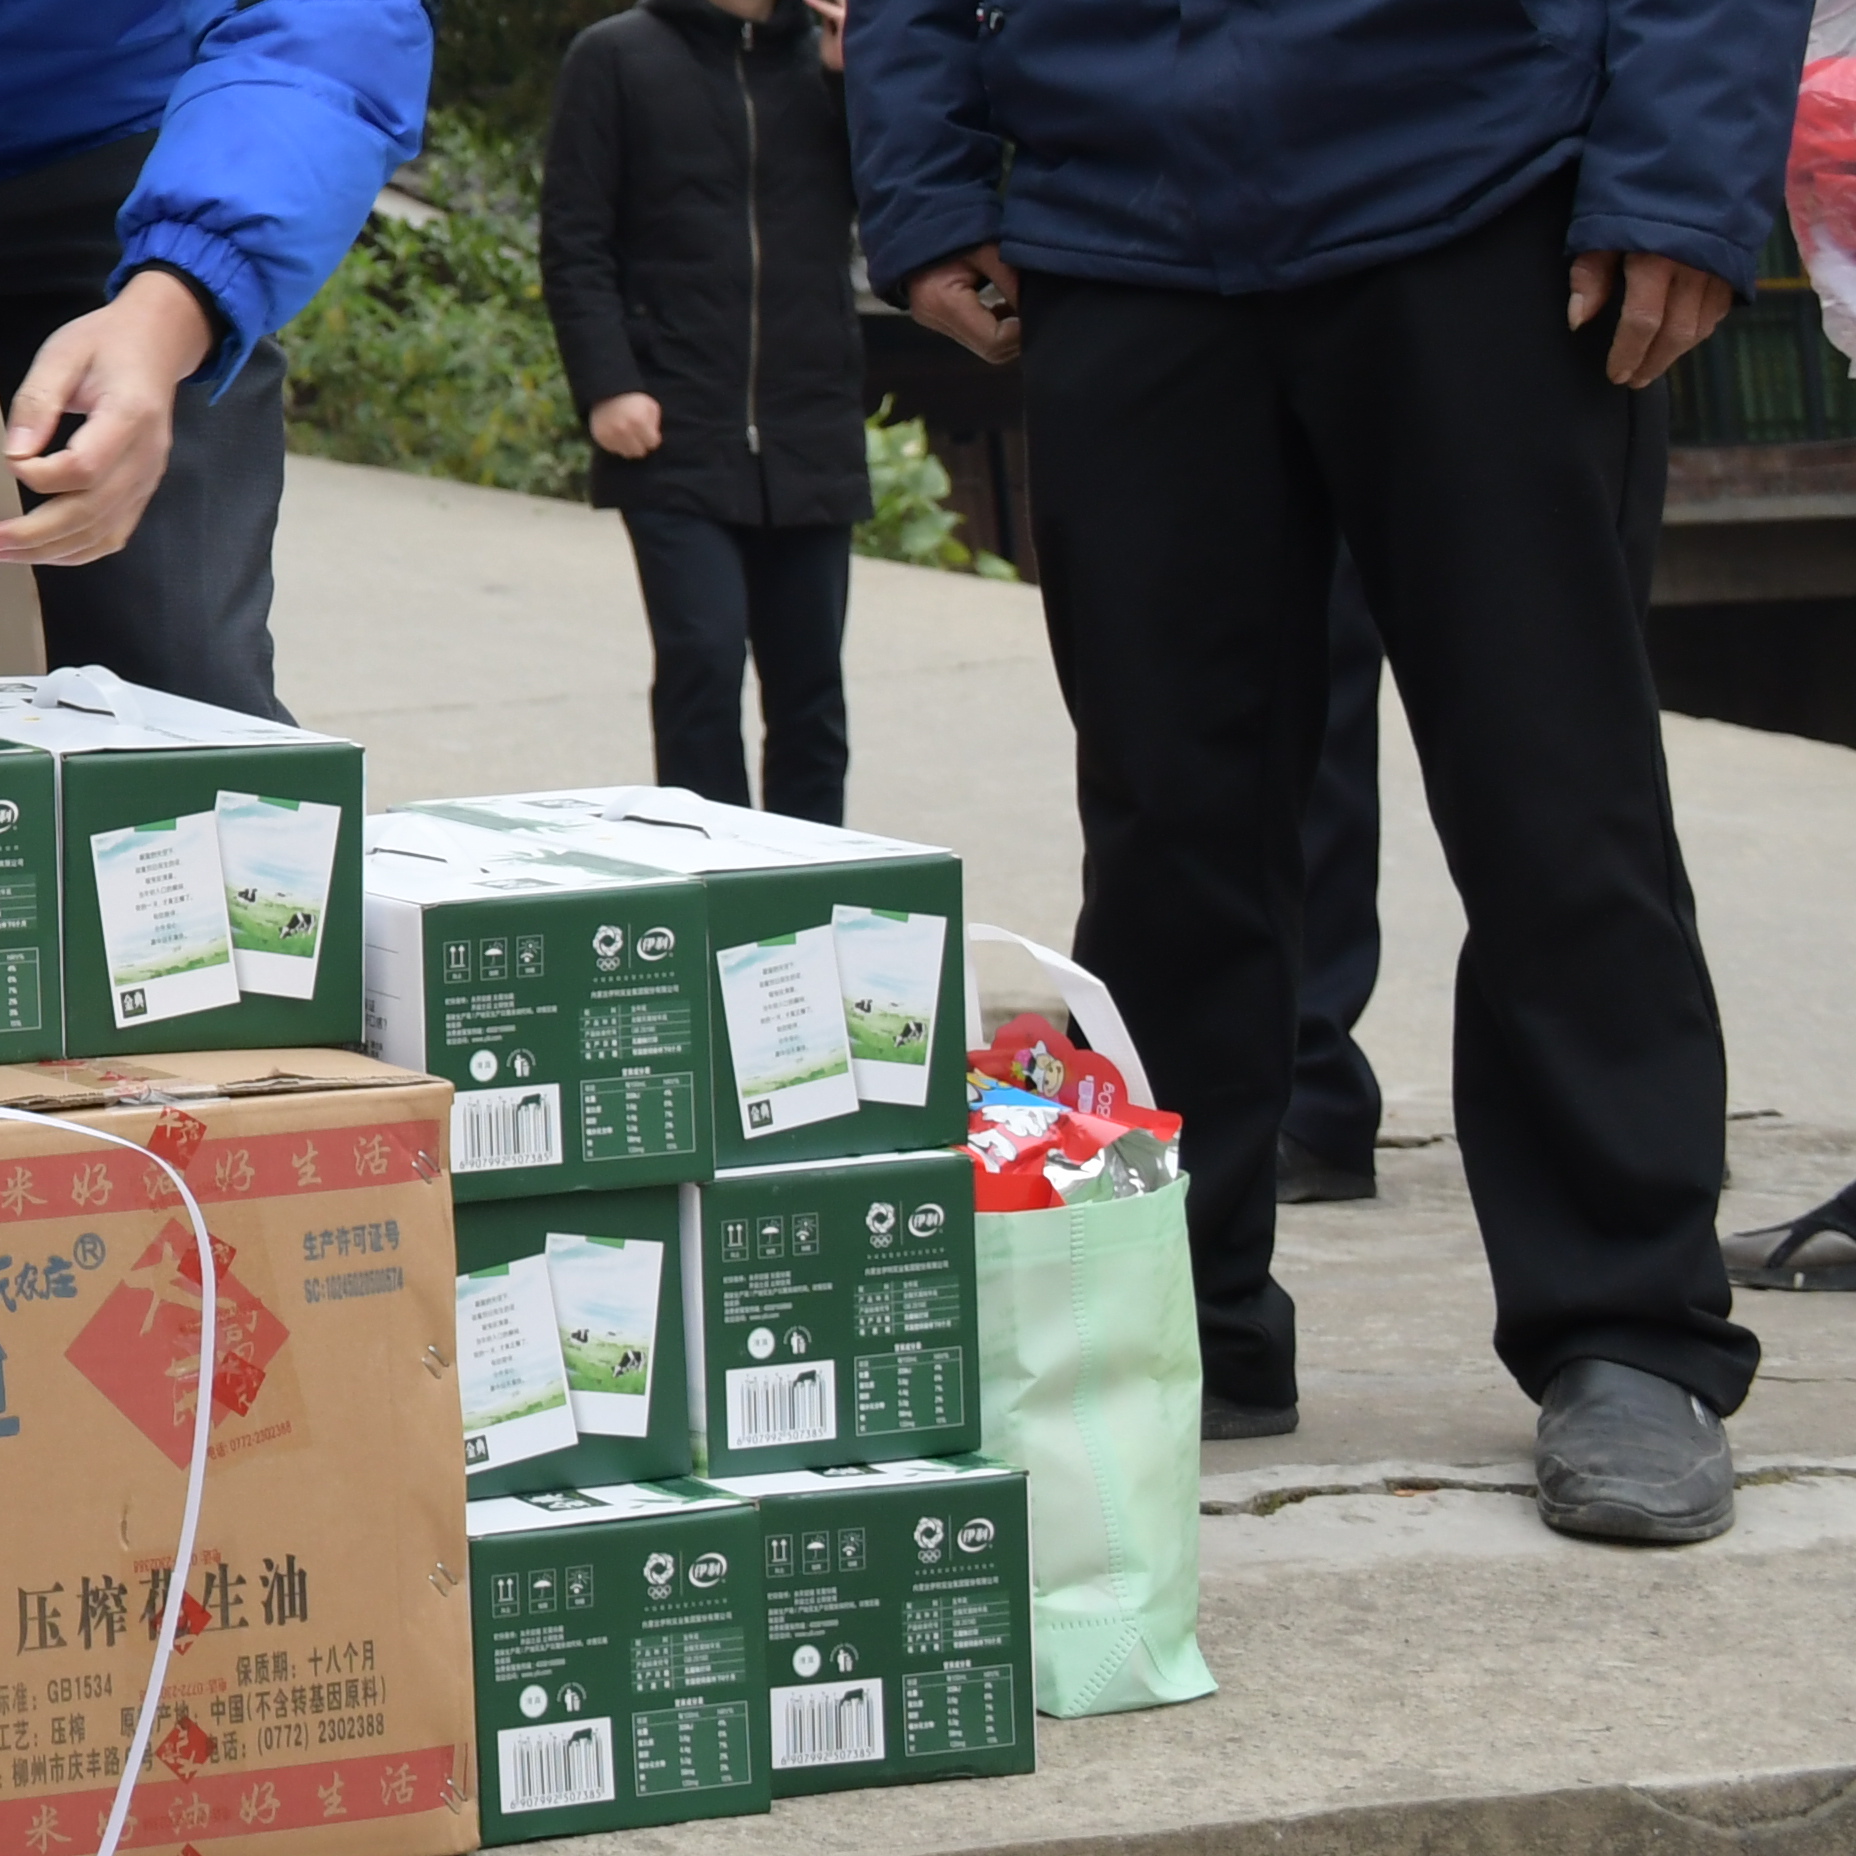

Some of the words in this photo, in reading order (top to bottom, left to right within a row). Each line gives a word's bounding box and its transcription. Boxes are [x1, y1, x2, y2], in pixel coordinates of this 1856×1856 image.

[302, 1220, 401, 1262] 生产许可证号
